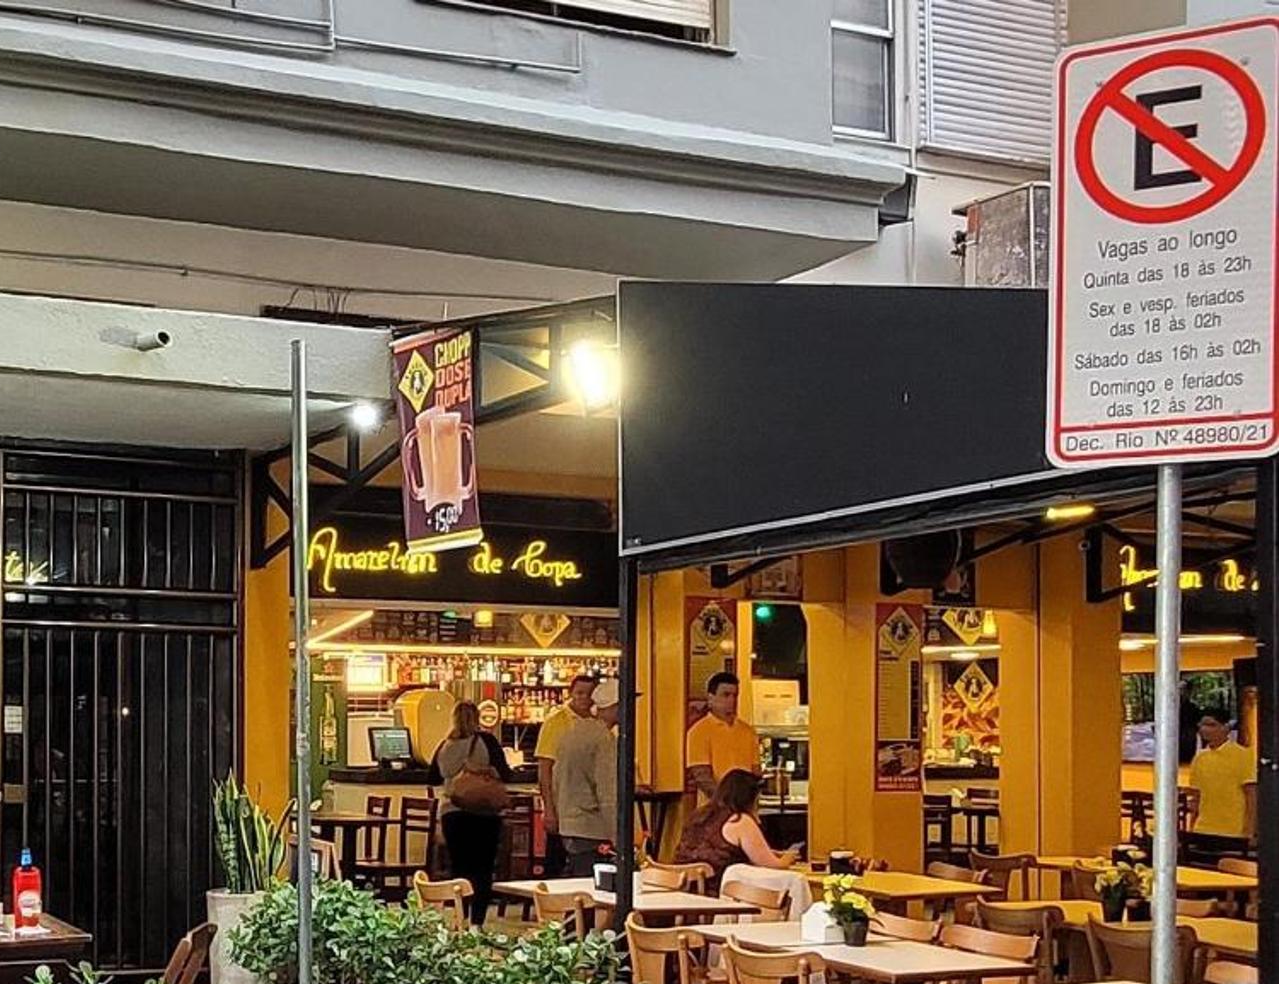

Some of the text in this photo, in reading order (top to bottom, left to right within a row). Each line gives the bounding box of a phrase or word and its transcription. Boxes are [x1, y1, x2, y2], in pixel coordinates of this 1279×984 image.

[1134, 85, 1202, 191] E
[1099, 229, 1237, 261] Vagas ao longo
[1084, 256, 1252, 289] Quinta das 18 às 23h
[1089, 289, 1244, 318] Sex e vesp. feriados
[1110, 313, 1221, 336] das 18 às 02h
[435, 331, 471, 368] CHOPP
[1075, 339, 1261, 370] Sábado das 16h às 02h
[435, 357, 471, 387] DOSE
[1090, 371, 1243, 397] Domingo e feriados
[435, 380, 471, 409] DUPLA
[1107, 395, 1223, 417] das 12 às 23h
[1066, 436, 1104, 452] Dec.
[1116, 432, 1143, 448] Rio
[1183, 424, 1267, 444] 48980/21
[472, 542, 503, 574] de
